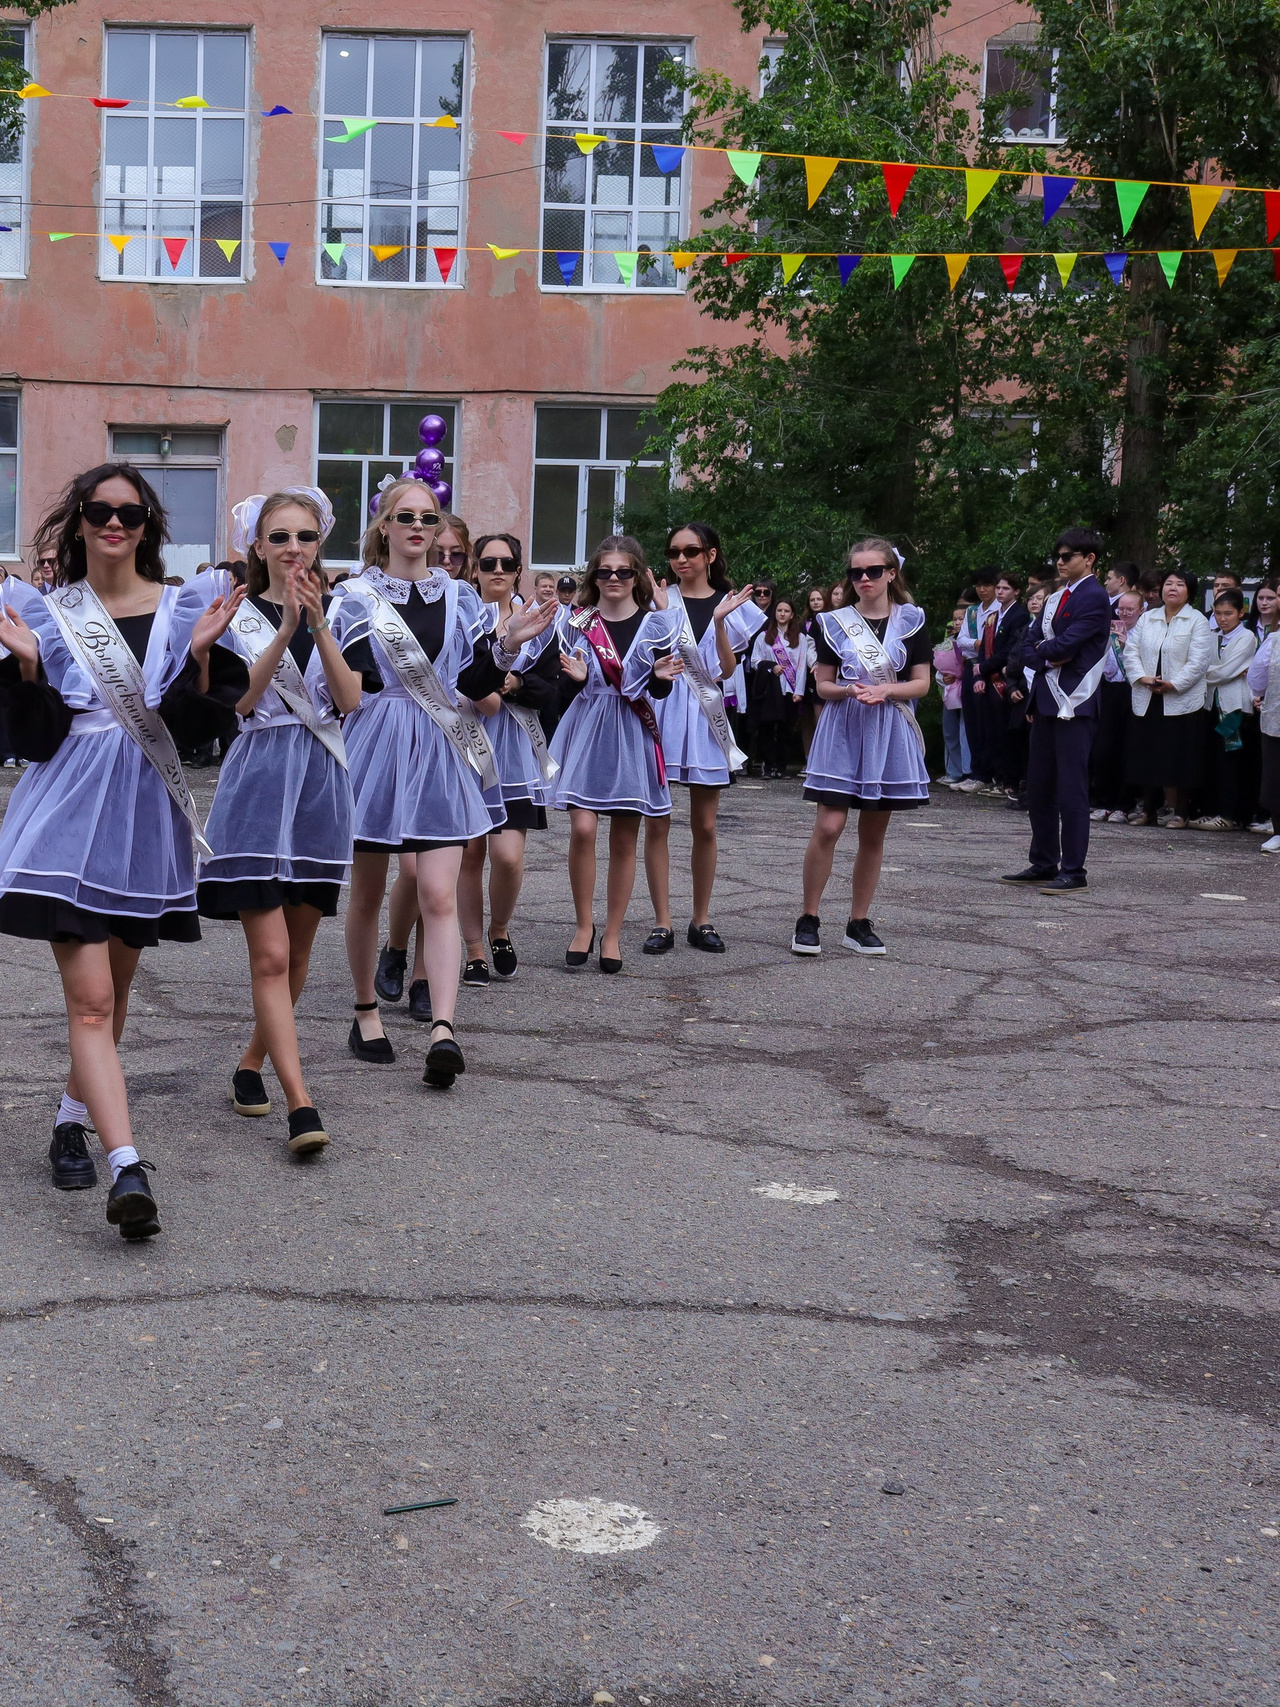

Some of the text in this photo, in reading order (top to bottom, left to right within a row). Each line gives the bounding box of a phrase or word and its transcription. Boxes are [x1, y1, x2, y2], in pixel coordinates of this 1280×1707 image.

[376, 622, 442, 712] Выпускница
[75, 621, 188, 810] Выпускница 2024
[465, 721, 488, 756] 2024
[525, 716, 544, 747] 2024
